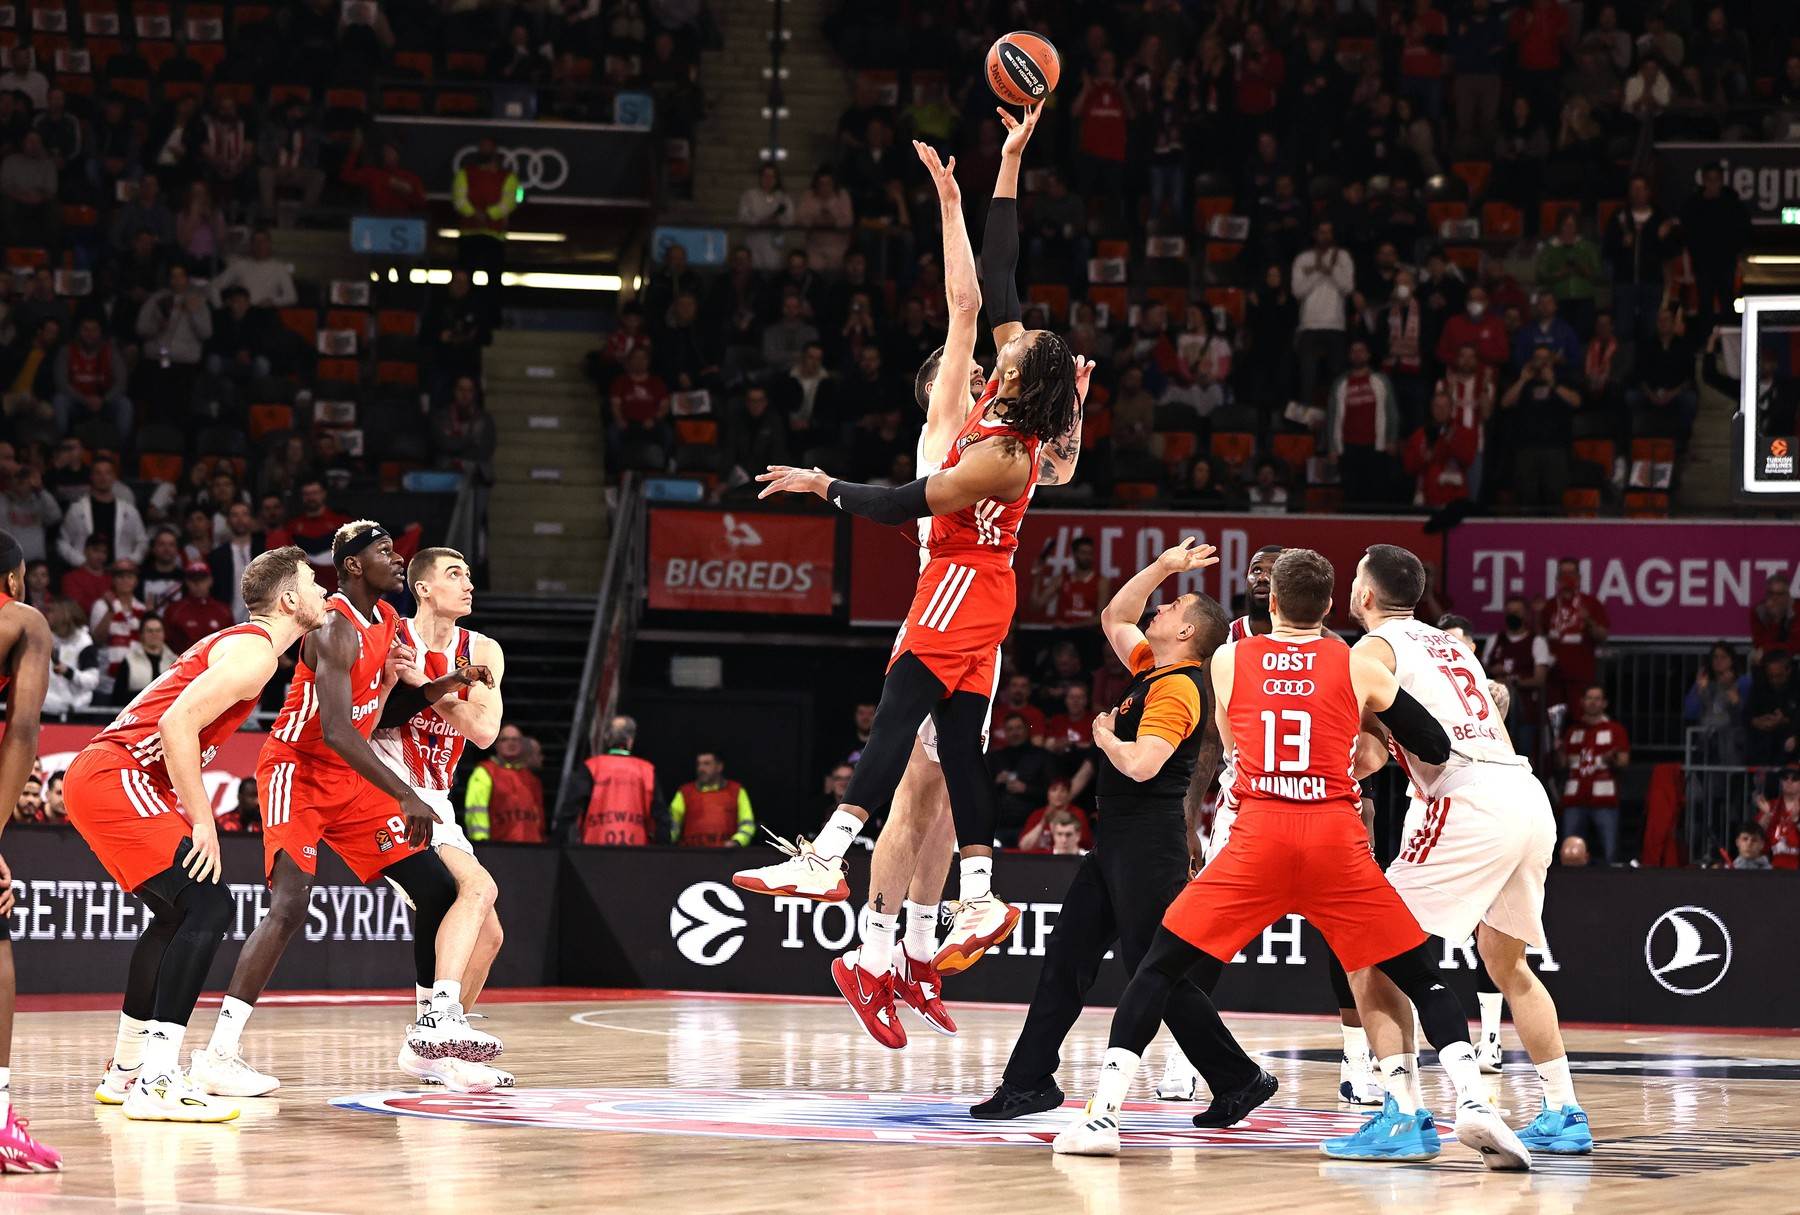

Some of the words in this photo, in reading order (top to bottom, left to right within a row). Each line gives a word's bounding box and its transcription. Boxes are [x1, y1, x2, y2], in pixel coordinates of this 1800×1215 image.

[989, 62, 1029, 104] SPALDING
[389, 224, 408, 251] S
[665, 558, 814, 592] BIGREDS
[1545, 557, 1800, 607] MAGENT
[1261, 652, 1317, 671] OBST
[1437, 665, 1490, 721] 13
[408, 712, 462, 737] eridi
[1260, 709, 1312, 773] 13
[1250, 776, 1328, 801] MUNICH
[386, 815, 408, 845] 9
[9, 879, 156, 941] GETHE
[304, 885, 414, 942] SYRIA
